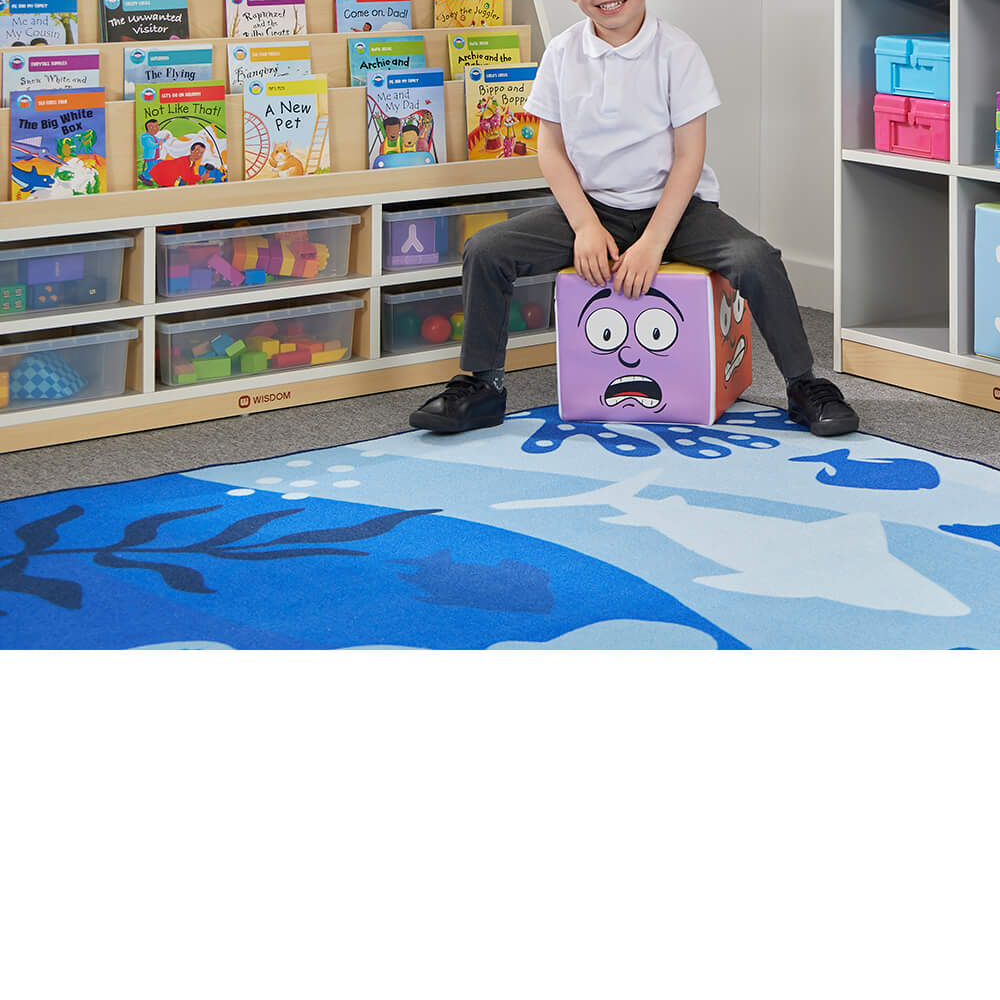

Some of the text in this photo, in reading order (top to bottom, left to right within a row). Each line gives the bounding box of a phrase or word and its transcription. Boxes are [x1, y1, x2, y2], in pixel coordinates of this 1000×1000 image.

[344, 8, 376, 19] Come
[387, 7, 409, 19] Dad!
[474, 6, 500, 20] Juggler
[12, 16, 48, 26] Me and
[108, 14, 183, 27] The Unwanted
[5, 28, 60, 40] My Cousin
[360, 57, 410, 71] Archie and
[458, 51, 511, 64] Archie and the
[145, 69, 196, 81] The Flying
[377, 90, 410, 101] Me and
[479, 84, 524, 95] Bippo and
[144, 103, 221, 118] Not Like That!
[265, 100, 312, 117] A New
[385, 99, 420, 113] My Dad
[18, 109, 93, 131] The Big White
[276, 117, 301, 131] Pet
[61, 121, 83, 135] Box
[253, 391, 291, 404] WISDOM
